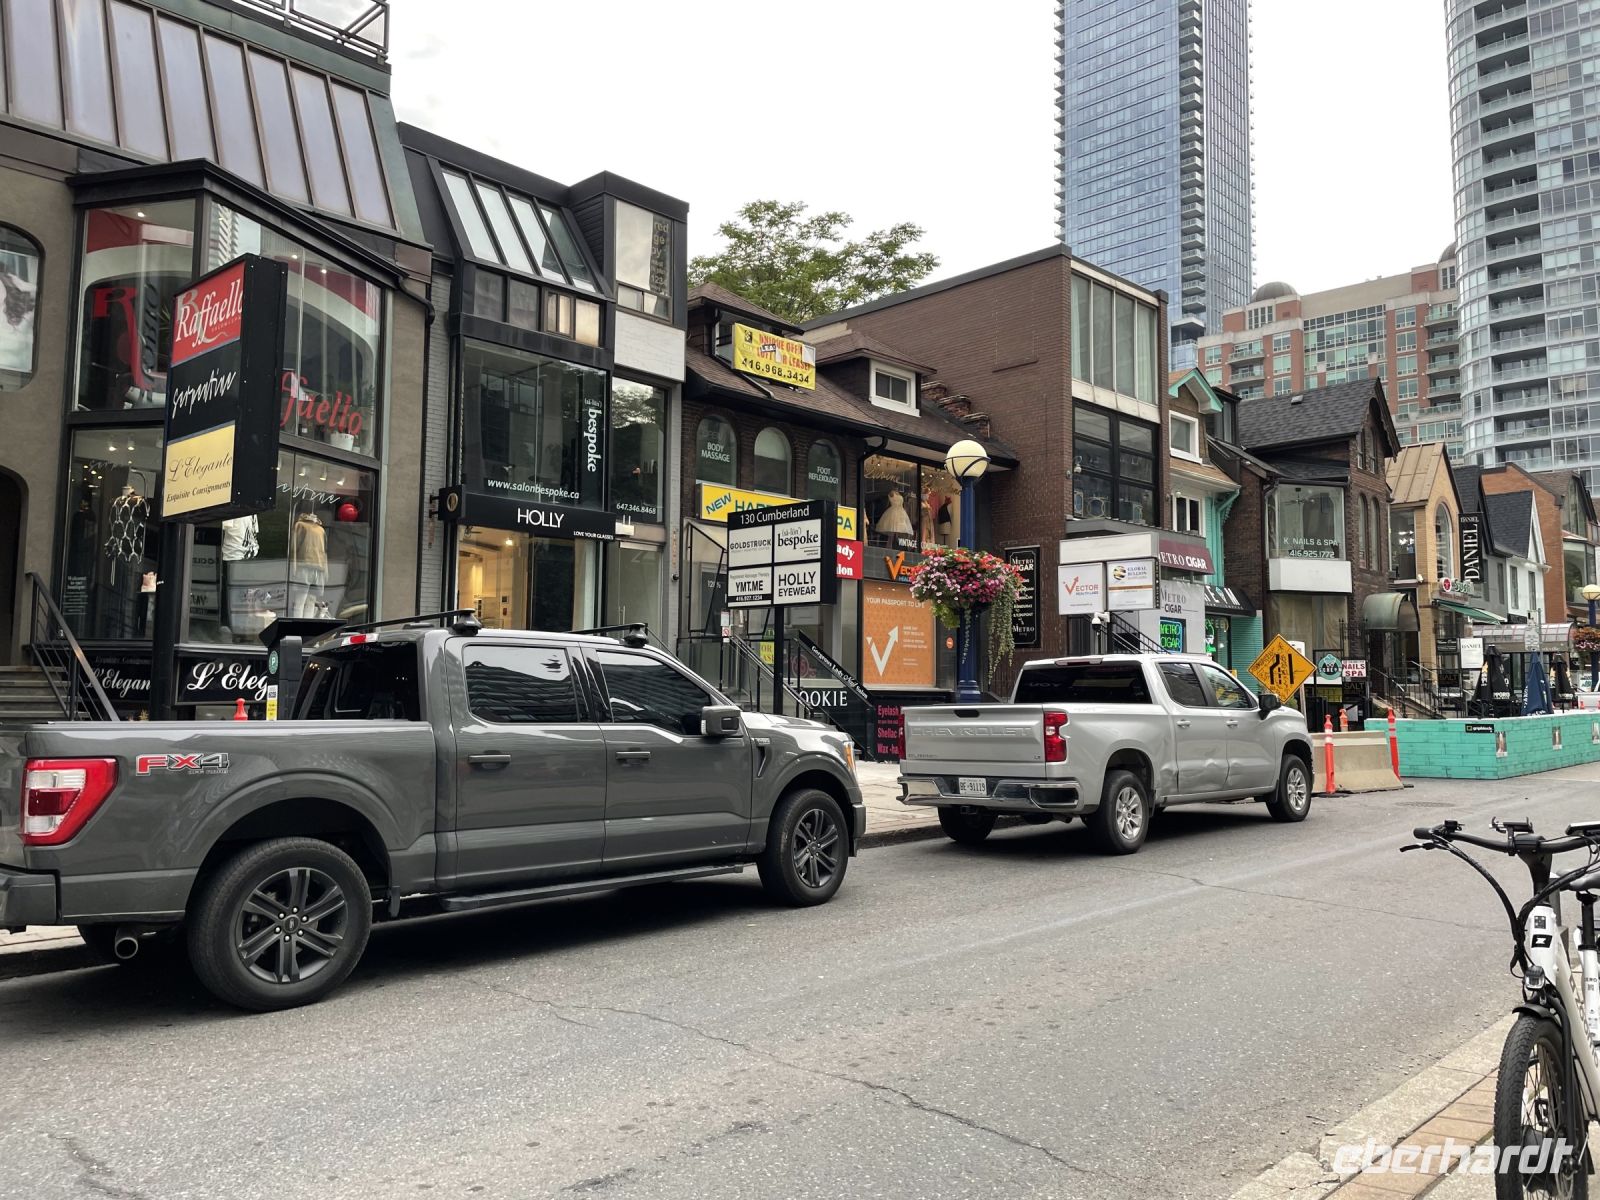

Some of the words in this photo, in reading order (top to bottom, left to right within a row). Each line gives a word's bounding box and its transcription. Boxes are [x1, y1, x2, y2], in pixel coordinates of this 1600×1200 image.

[742, 358, 810, 384] 416.968.3434
[583, 408, 603, 472] bespoke
[707, 442, 725, 453] BODY
[701, 450, 731, 463] MASSAGE
[816, 466, 831, 475] FOOT
[487, 478, 580, 500] www.salonbespoke.ca
[705, 492, 732, 516] NEW
[517, 507, 565, 529] HOLLY
[741, 513, 756, 526] 130
[756, 505, 810, 523] Cumberland
[729, 539, 772, 550] GOLDSTRUCK
[777, 530, 819, 550] bespoke
[1283, 537, 1289, 545] K
[1292, 537, 1315, 546] NAILS
[1323, 539, 1339, 547] SPA
[1463, 523, 1480, 580] DANIEL
[1185, 556, 1208, 570] CIGAR
[735, 580, 764, 593] YMT.ME
[778, 571, 817, 587] HOLLY
[778, 586, 817, 597] EYEWEAR
[1159, 585, 1187, 604] METRO
[1164, 604, 1182, 614] CIGAR
[911, 727, 1032, 736] CHEVROLET
[136, 752, 230, 777] FX4
